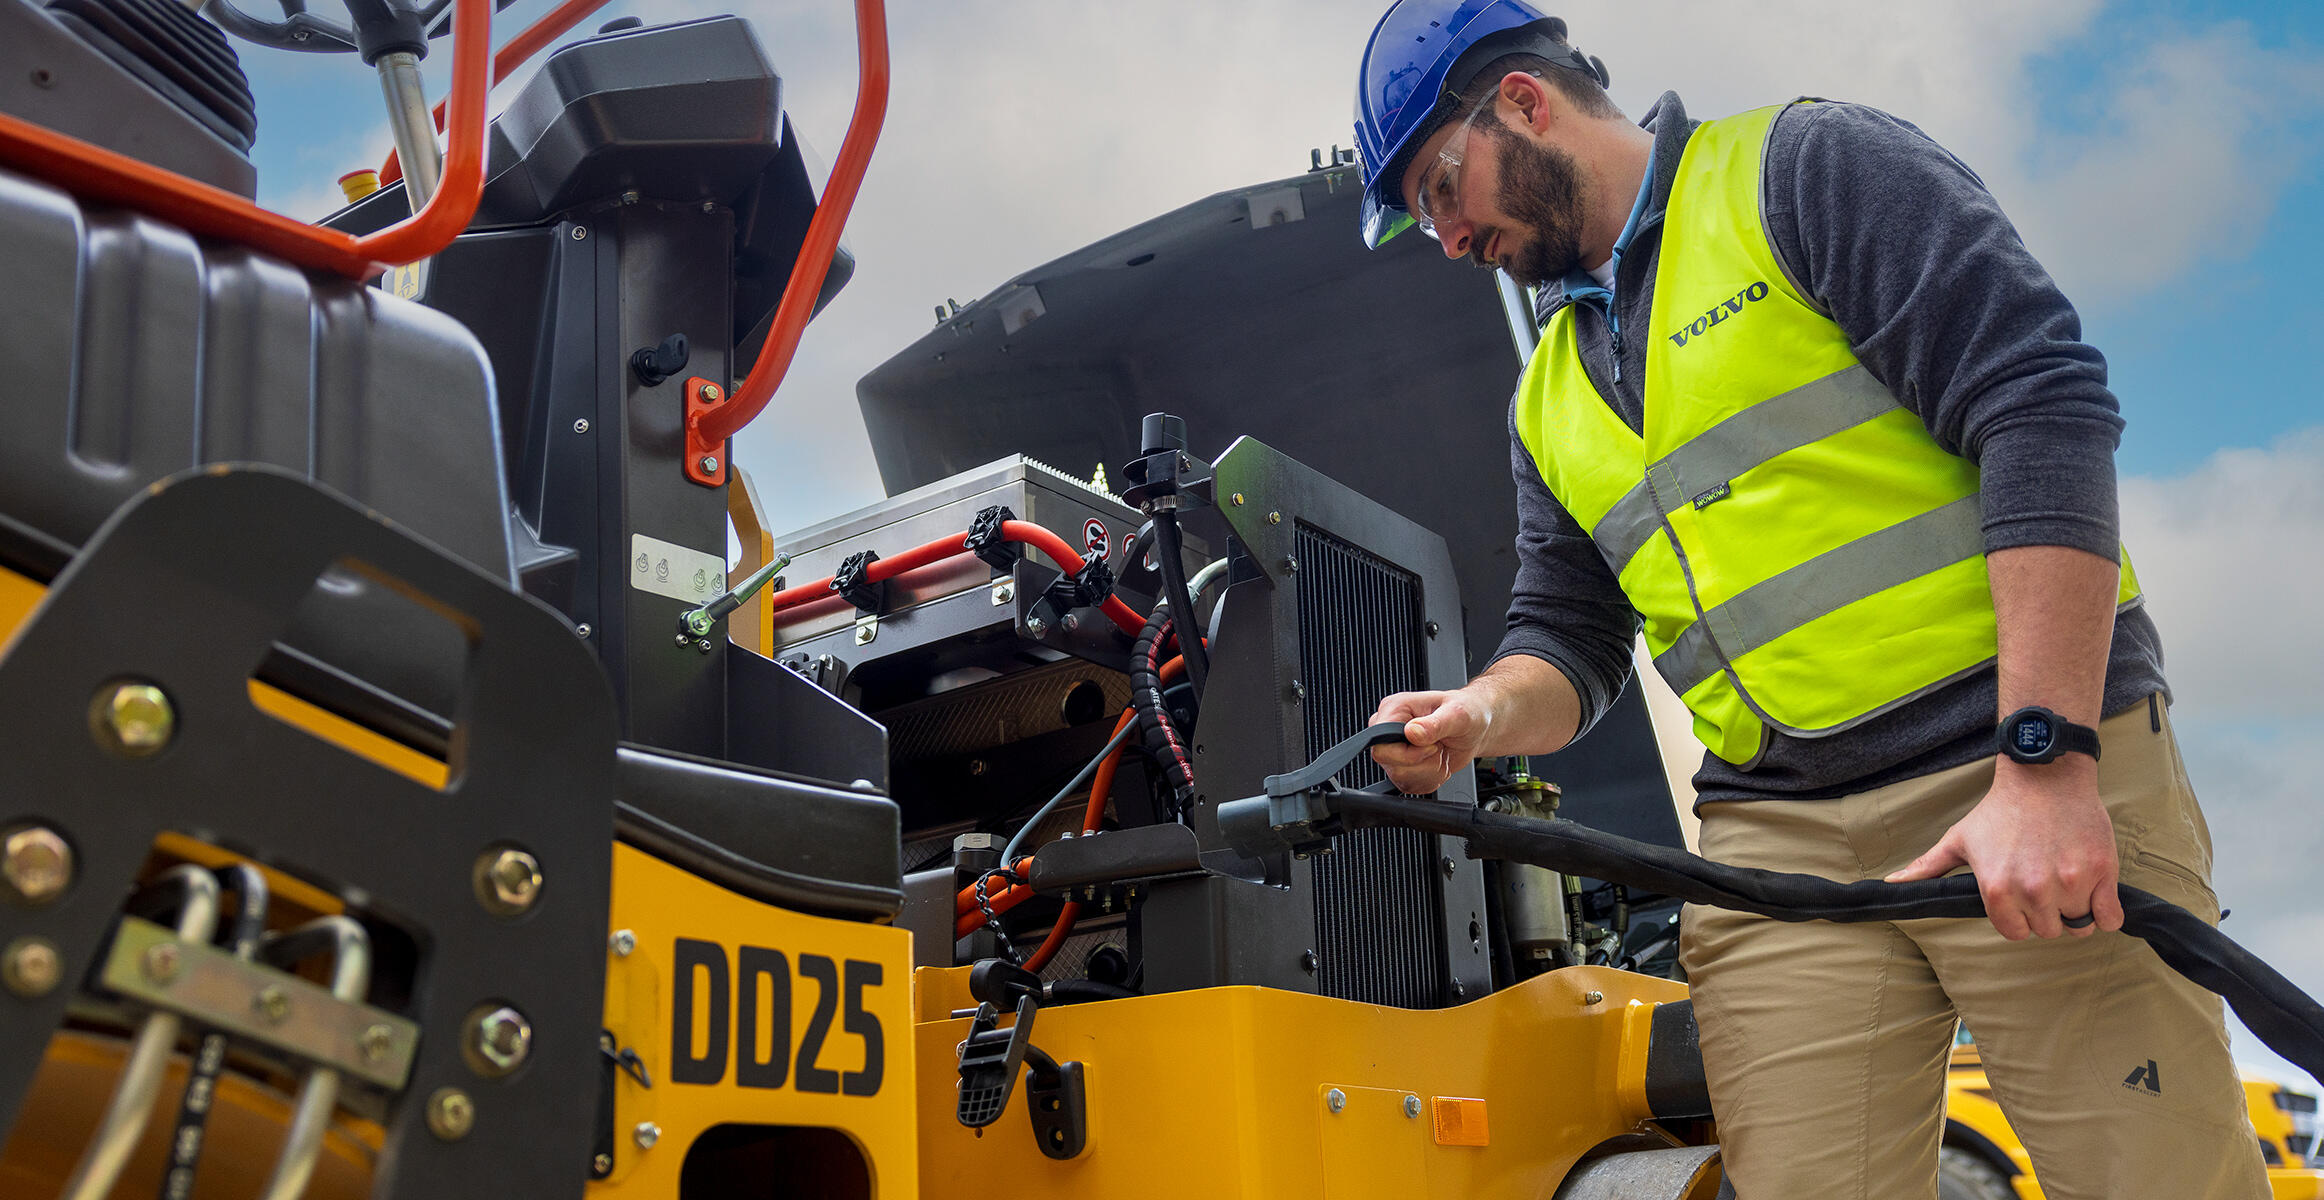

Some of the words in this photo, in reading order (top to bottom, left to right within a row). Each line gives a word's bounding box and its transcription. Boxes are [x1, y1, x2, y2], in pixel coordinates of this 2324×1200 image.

[1669, 281, 1769, 348] VOLVO
[1696, 488, 1725, 507] WOWOW
[1150, 687, 1162, 709] GATES
[2022, 723, 2034, 745] 1444
[670, 936, 885, 1098] DD25
